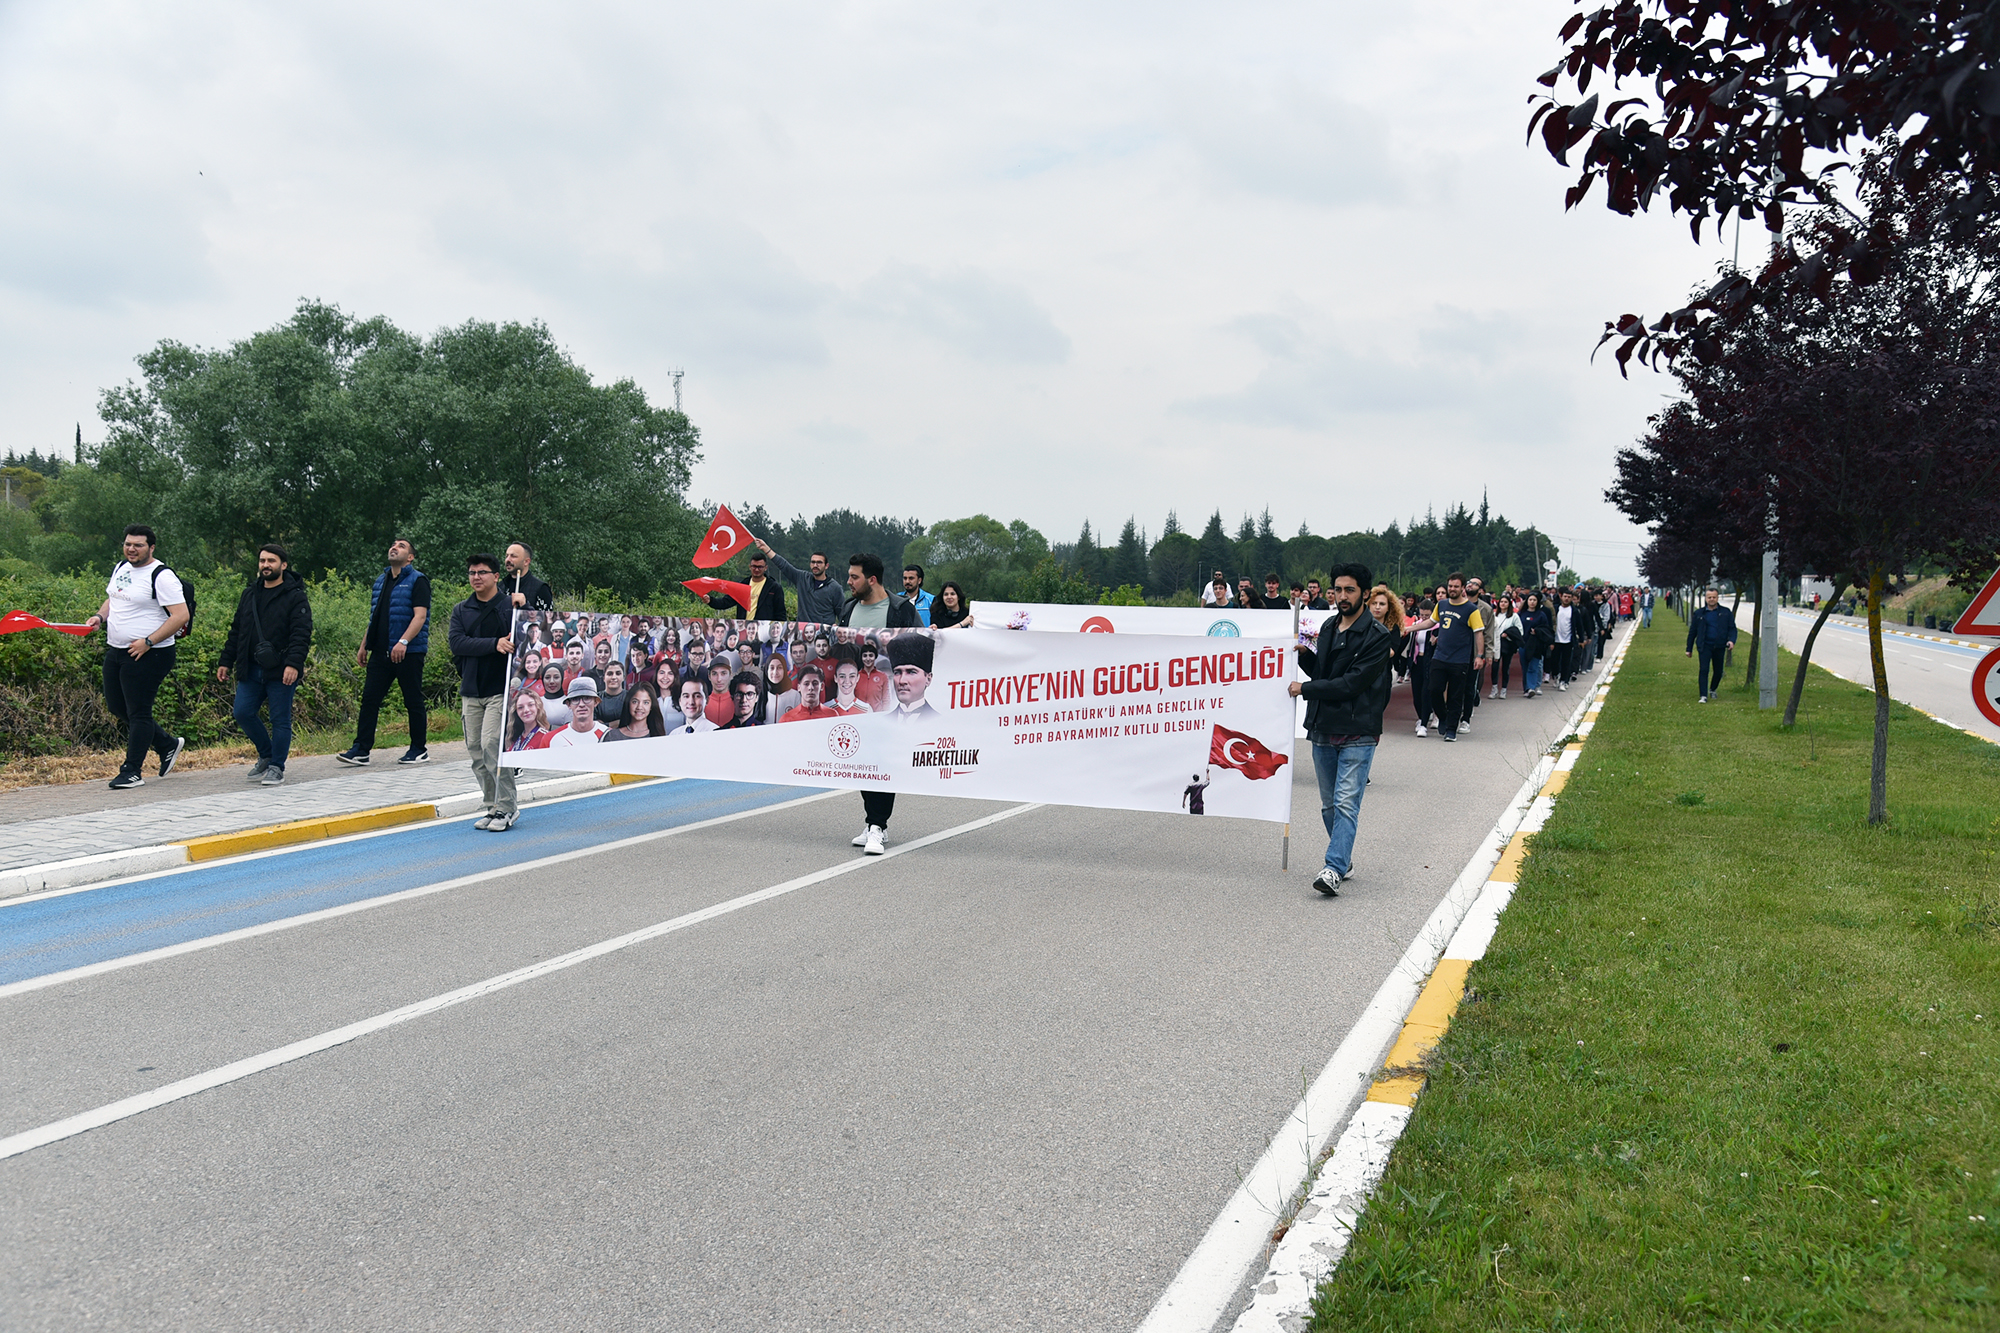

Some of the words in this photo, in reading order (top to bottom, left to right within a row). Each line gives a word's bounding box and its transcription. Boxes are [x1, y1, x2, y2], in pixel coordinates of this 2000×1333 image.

[1442, 617, 1452, 629] 3
[947, 668, 1085, 710] TÜRKİYE'NİN
[1093, 661, 1163, 695] GÜCÜ,
[1168, 646, 1284, 687] GENÇLİĞİ
[998, 715, 1010, 727] 19
[1014, 712, 1049, 726] MAYIS
[1053, 705, 1115, 723] ATATÜRK'Ü
[1120, 703, 1152, 717] ANMA
[1157, 697, 1206, 714] GENÇLİK
[1210, 697, 1224, 709] VE
[1014, 732, 1043, 745] SPOR
[1047, 726, 1119, 742] BAYRAMIMIZ
[1124, 721, 1159, 736] KUTLU
[1164, 719, 1205, 733] OLSUN!
[937, 736, 956, 749] 2024
[912, 748, 980, 767] HAREKETLİLİK
[807, 760, 833, 770] TÜRKİYE
[834, 762, 879, 772] CUMHURİYETİ
[939, 767, 952, 779] YILI
[793, 768, 822, 777] GENÇLİK
[833, 770, 852, 779] SPOR
[852, 772, 891, 782] BAKANLIĞI
